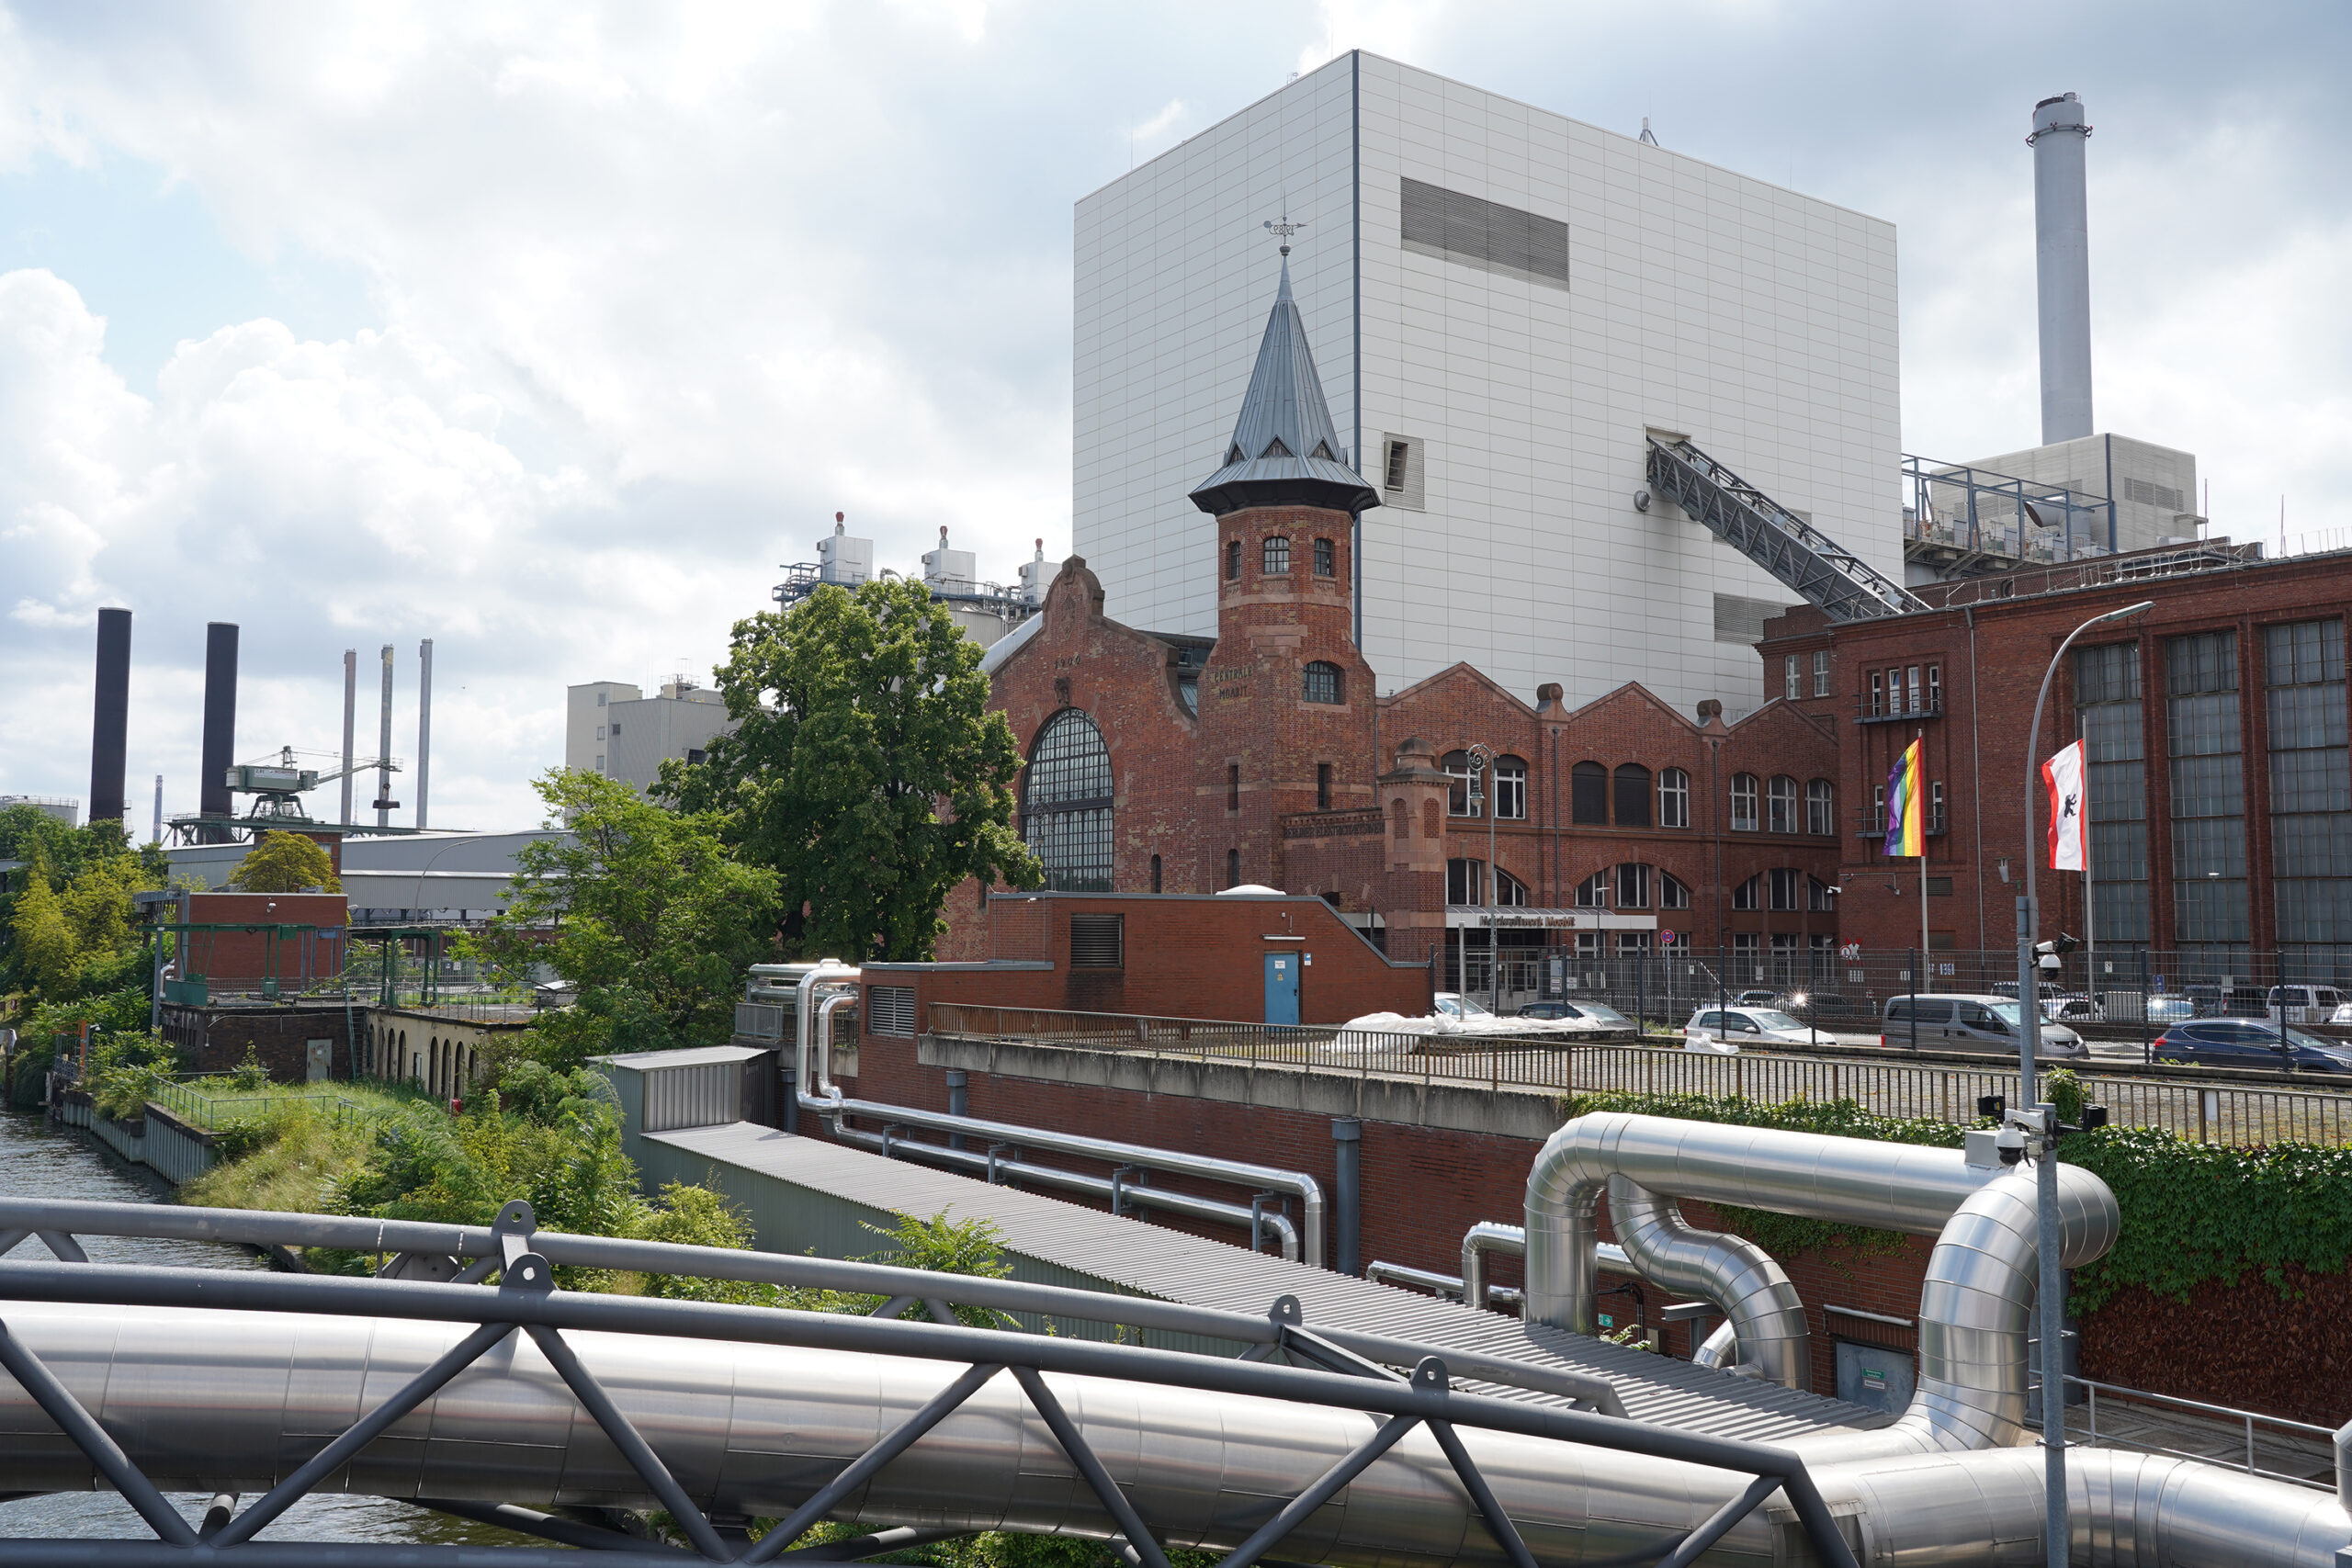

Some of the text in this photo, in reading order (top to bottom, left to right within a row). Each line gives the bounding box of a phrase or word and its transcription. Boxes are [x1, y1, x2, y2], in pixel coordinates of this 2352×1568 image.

[1054, 655, 1080, 669] 1900
[1215, 665, 1252, 682] CENTRALE
[1219, 685, 1248, 699] MOABIT
[1283, 827, 1314, 839] BERLINER
[1545, 916, 1576, 927] Moabit
